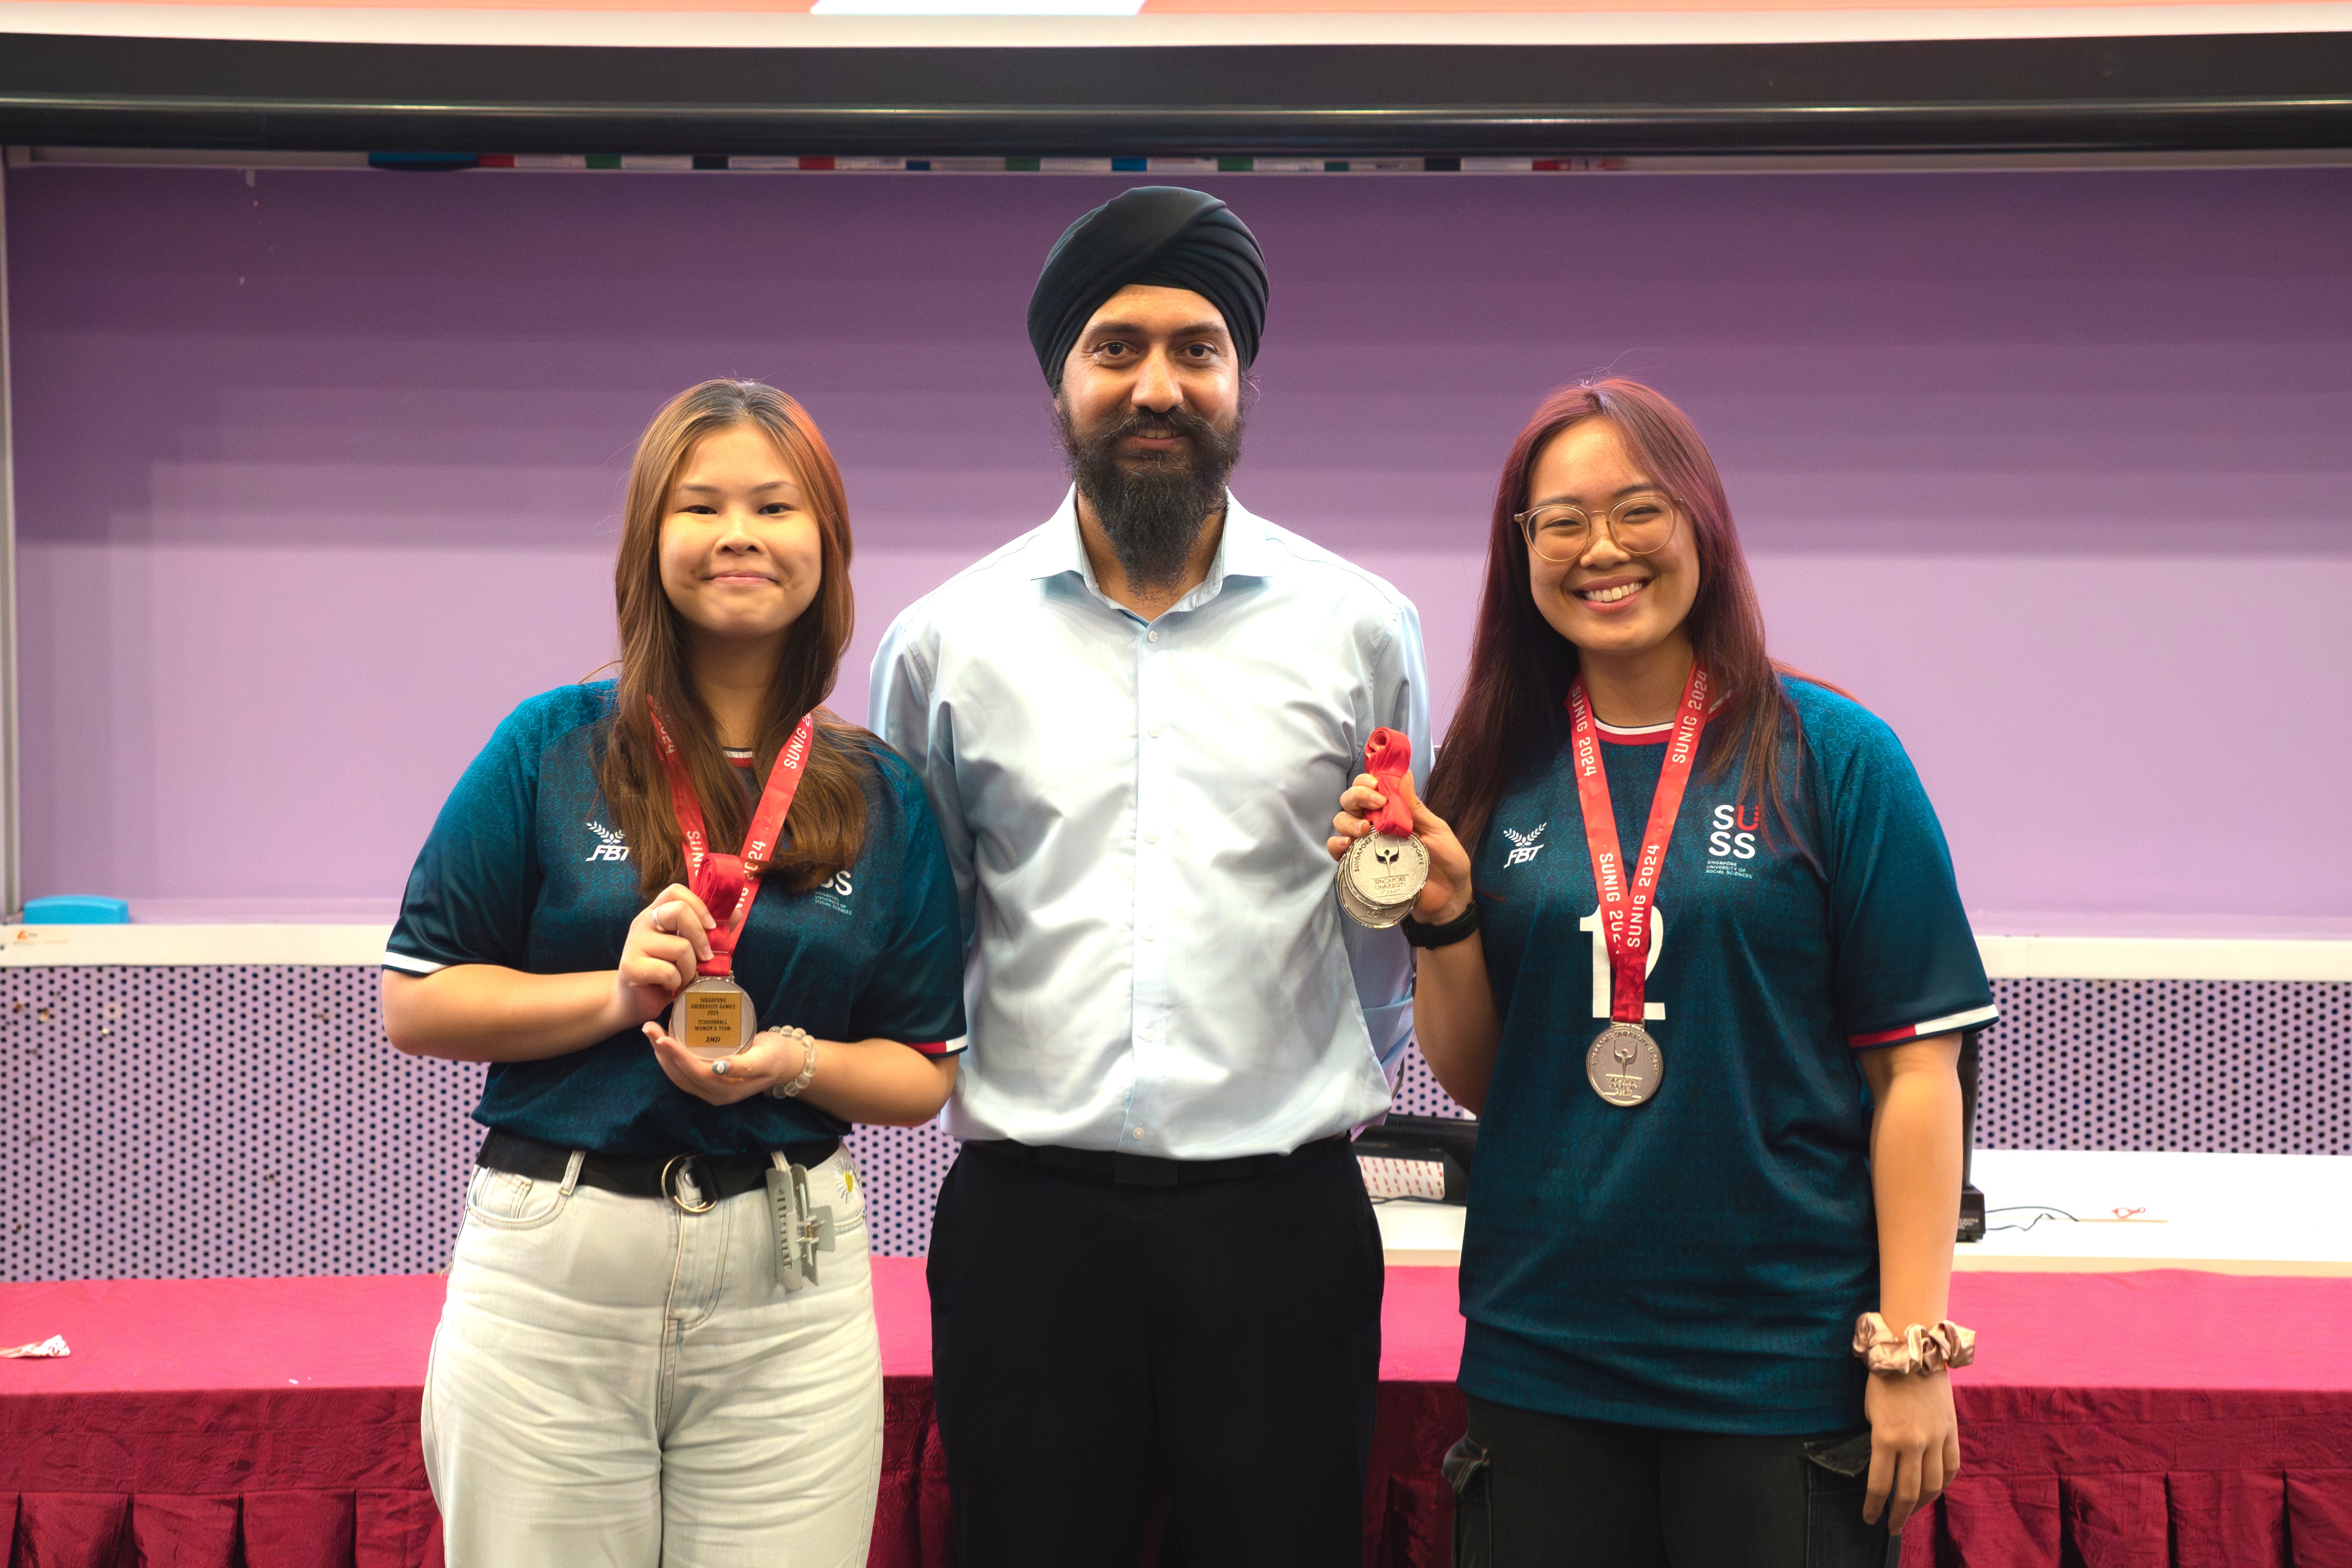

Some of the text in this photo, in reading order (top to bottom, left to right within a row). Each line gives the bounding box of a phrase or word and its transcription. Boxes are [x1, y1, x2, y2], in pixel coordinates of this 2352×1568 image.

[1572, 686, 1597, 777] SUNIG 2024
[1672, 670, 1707, 764] SUNIG 2024
[783, 727, 807, 769] SUNIG
[1504, 844, 1544, 869] FBT
[1709, 831, 1755, 859] SS
[1599, 853, 1621, 902] SUNIG
[1627, 844, 1660, 948] SUNIG 2024
[1726, 870, 1753, 879] SCIENCES
